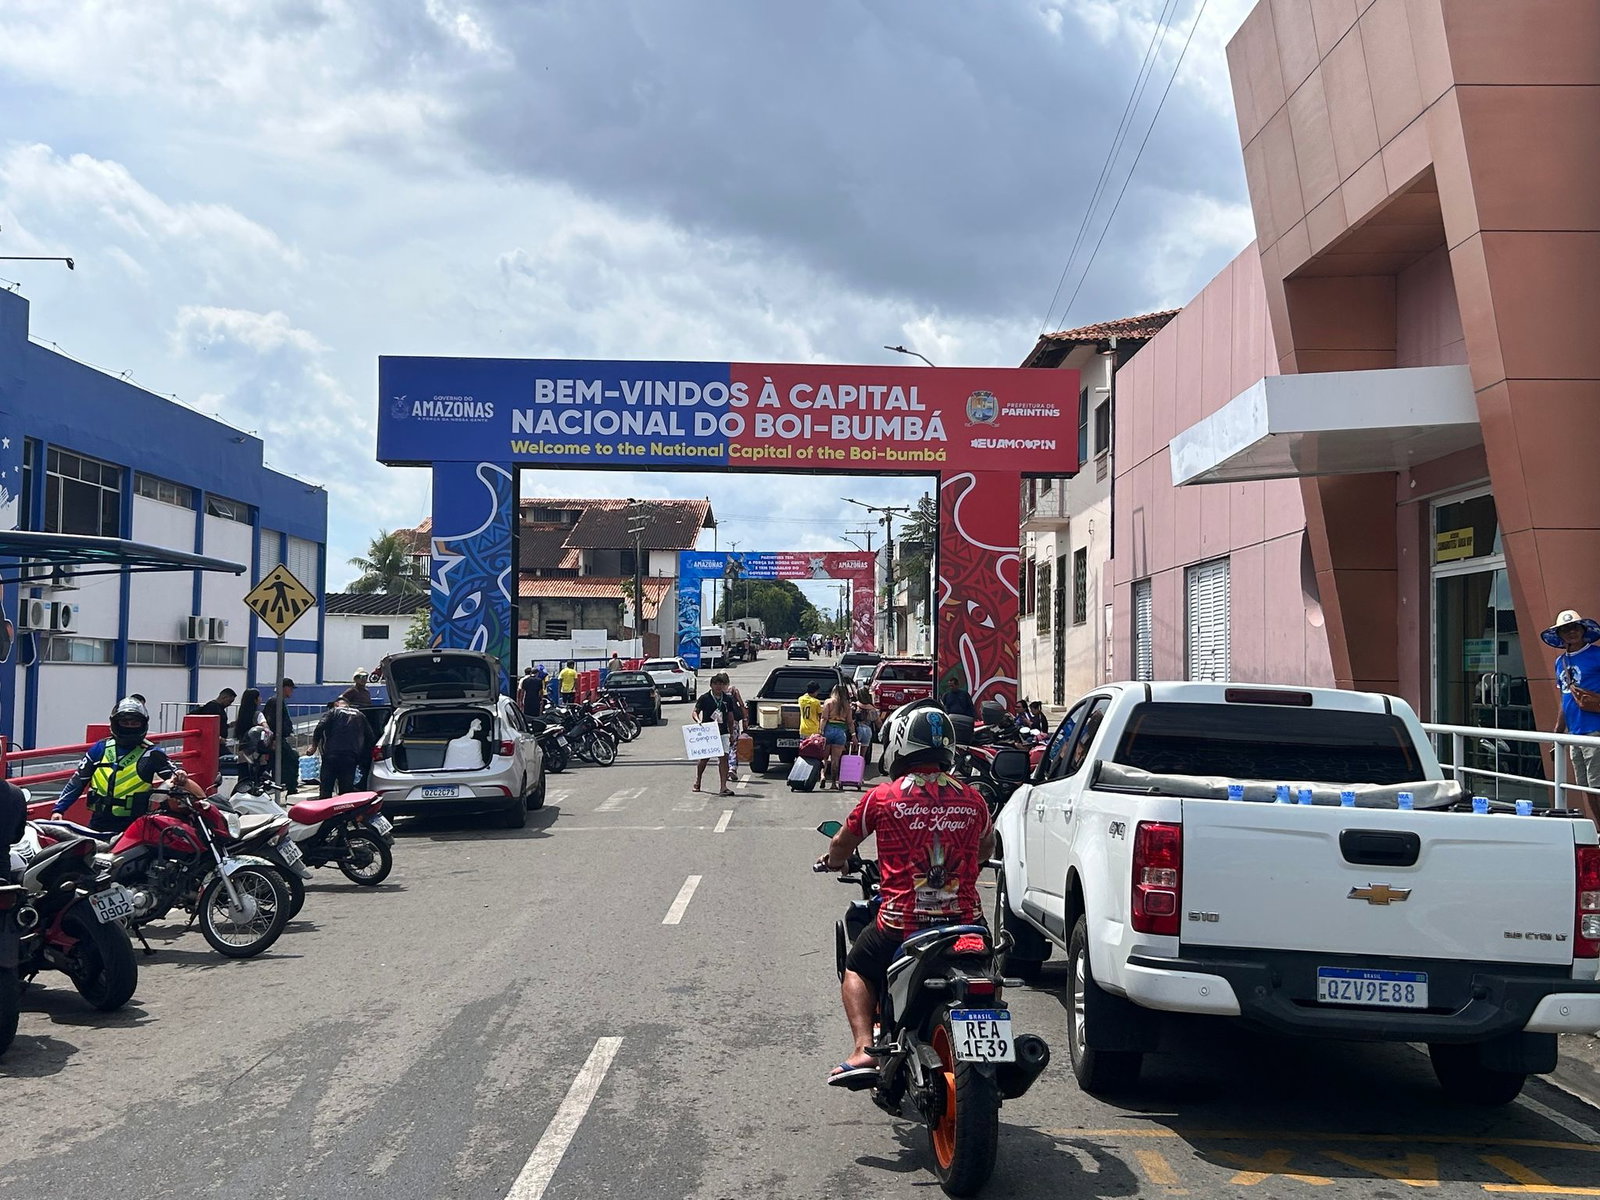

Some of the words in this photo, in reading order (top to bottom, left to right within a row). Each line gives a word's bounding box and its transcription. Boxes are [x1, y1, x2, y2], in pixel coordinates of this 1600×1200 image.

[535, 379, 749, 408] BEM-VINDOS
[757, 377, 780, 408] À
[789, 383, 926, 411] CAPITAL
[412, 400, 494, 418] AMAZONAS
[1001, 408, 1060, 417] PARINTINS
[511, 409, 685, 436] NACIONAL
[694, 411, 745, 438] DO
[755, 410, 948, 442] BOI-BUMBÁ
[511, 439, 590, 455] Welcome
[595, 441, 613, 455] to
[618, 442, 646, 456] the
[650, 442, 724, 457] National
[728, 443, 791, 461] Capital
[796, 445, 814, 460] of
[817, 446, 845, 460] the
[850, 446, 947, 462] Boi-bumbá
[838, 561, 868, 569] AMAZONAS
[931, 806, 945, 815] os
[945, 806, 978, 817] povos
[909, 817, 927, 830] do
[100, 902, 132, 921] 0902
[1187, 910, 1220, 923] S10
[1327, 980, 1415, 1004] QZV9E88
[966, 1021, 1001, 1039] REA
[963, 1040, 1008, 1058] 1E39
